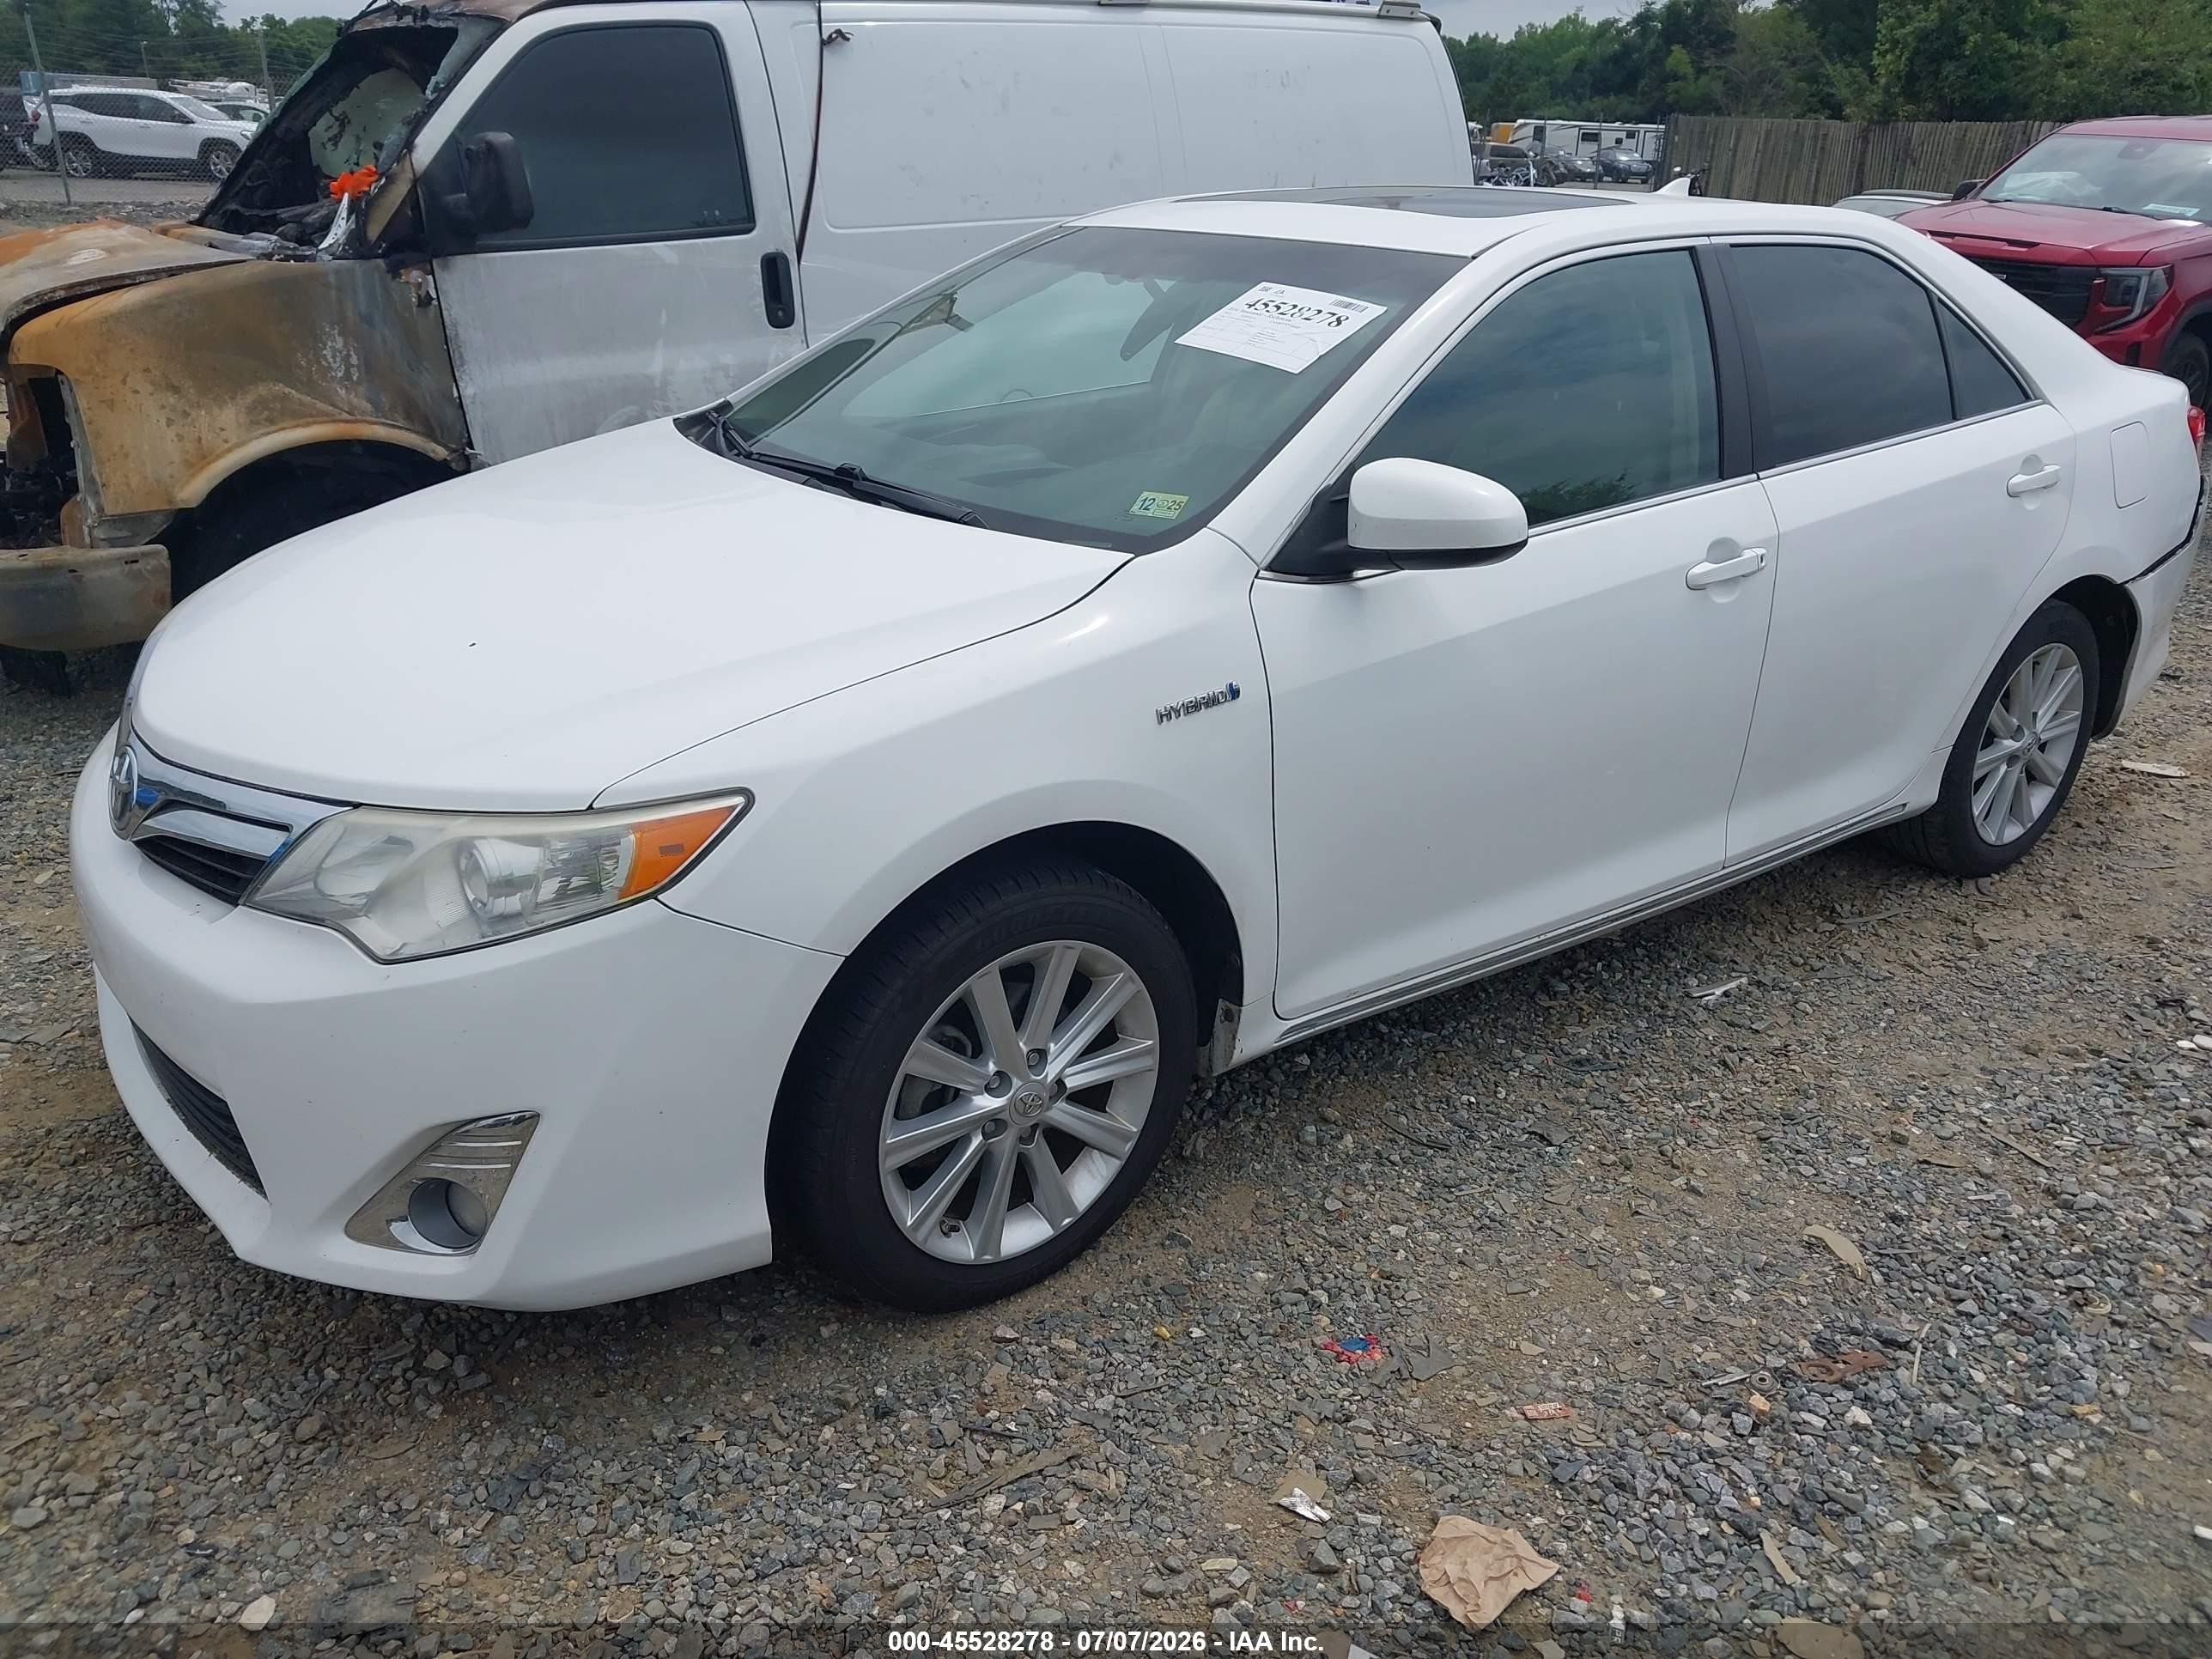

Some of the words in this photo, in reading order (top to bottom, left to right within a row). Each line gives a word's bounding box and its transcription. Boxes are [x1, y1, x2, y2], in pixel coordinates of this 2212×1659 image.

[1245, 298, 1349, 327] 45528278
[1139, 497, 1156, 510] 12
[1166, 500, 1184, 510] 25
[1156, 688, 1229, 725] HYBRID
